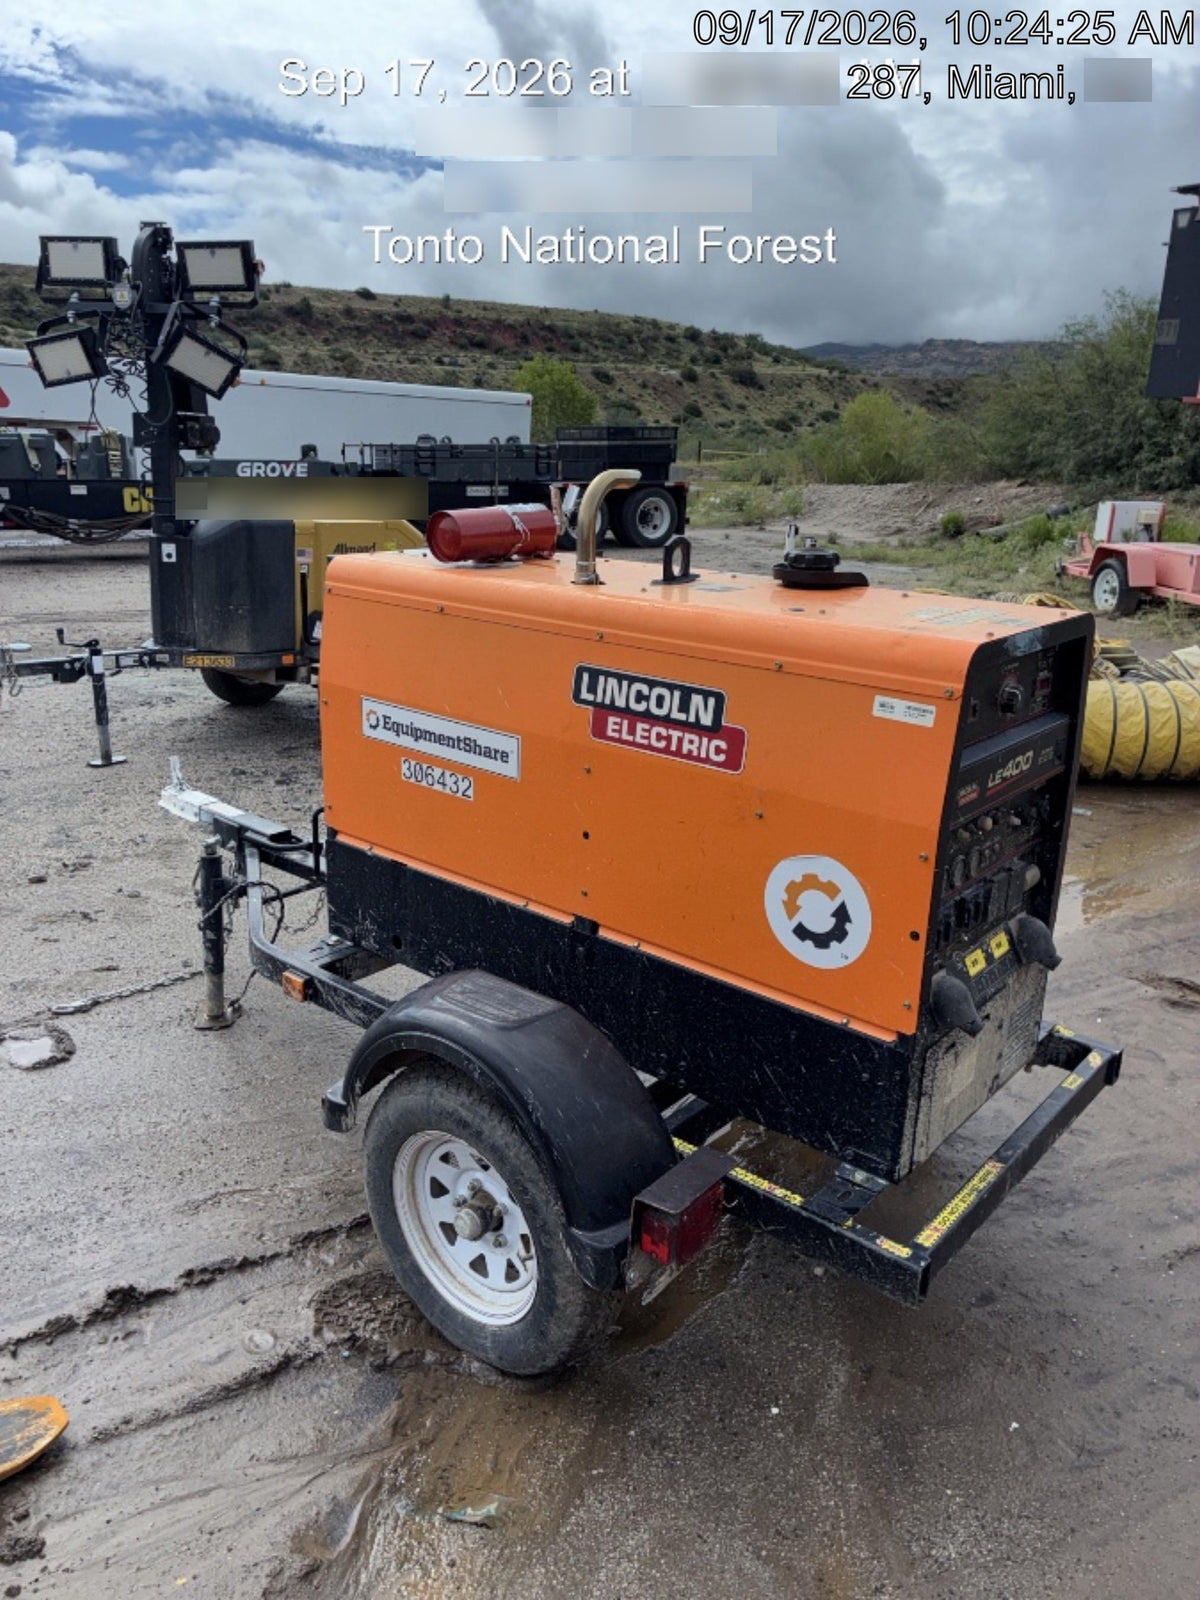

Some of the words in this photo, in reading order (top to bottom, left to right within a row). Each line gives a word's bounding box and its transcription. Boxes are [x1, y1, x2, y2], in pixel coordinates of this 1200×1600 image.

[236, 462, 309, 477] GROVE
[580, 672, 716, 726] LINCOLN
[381, 714, 510, 764] EquipmentShare
[606, 716, 728, 762] ELECTRIC
[402, 758, 473, 799] 306432
